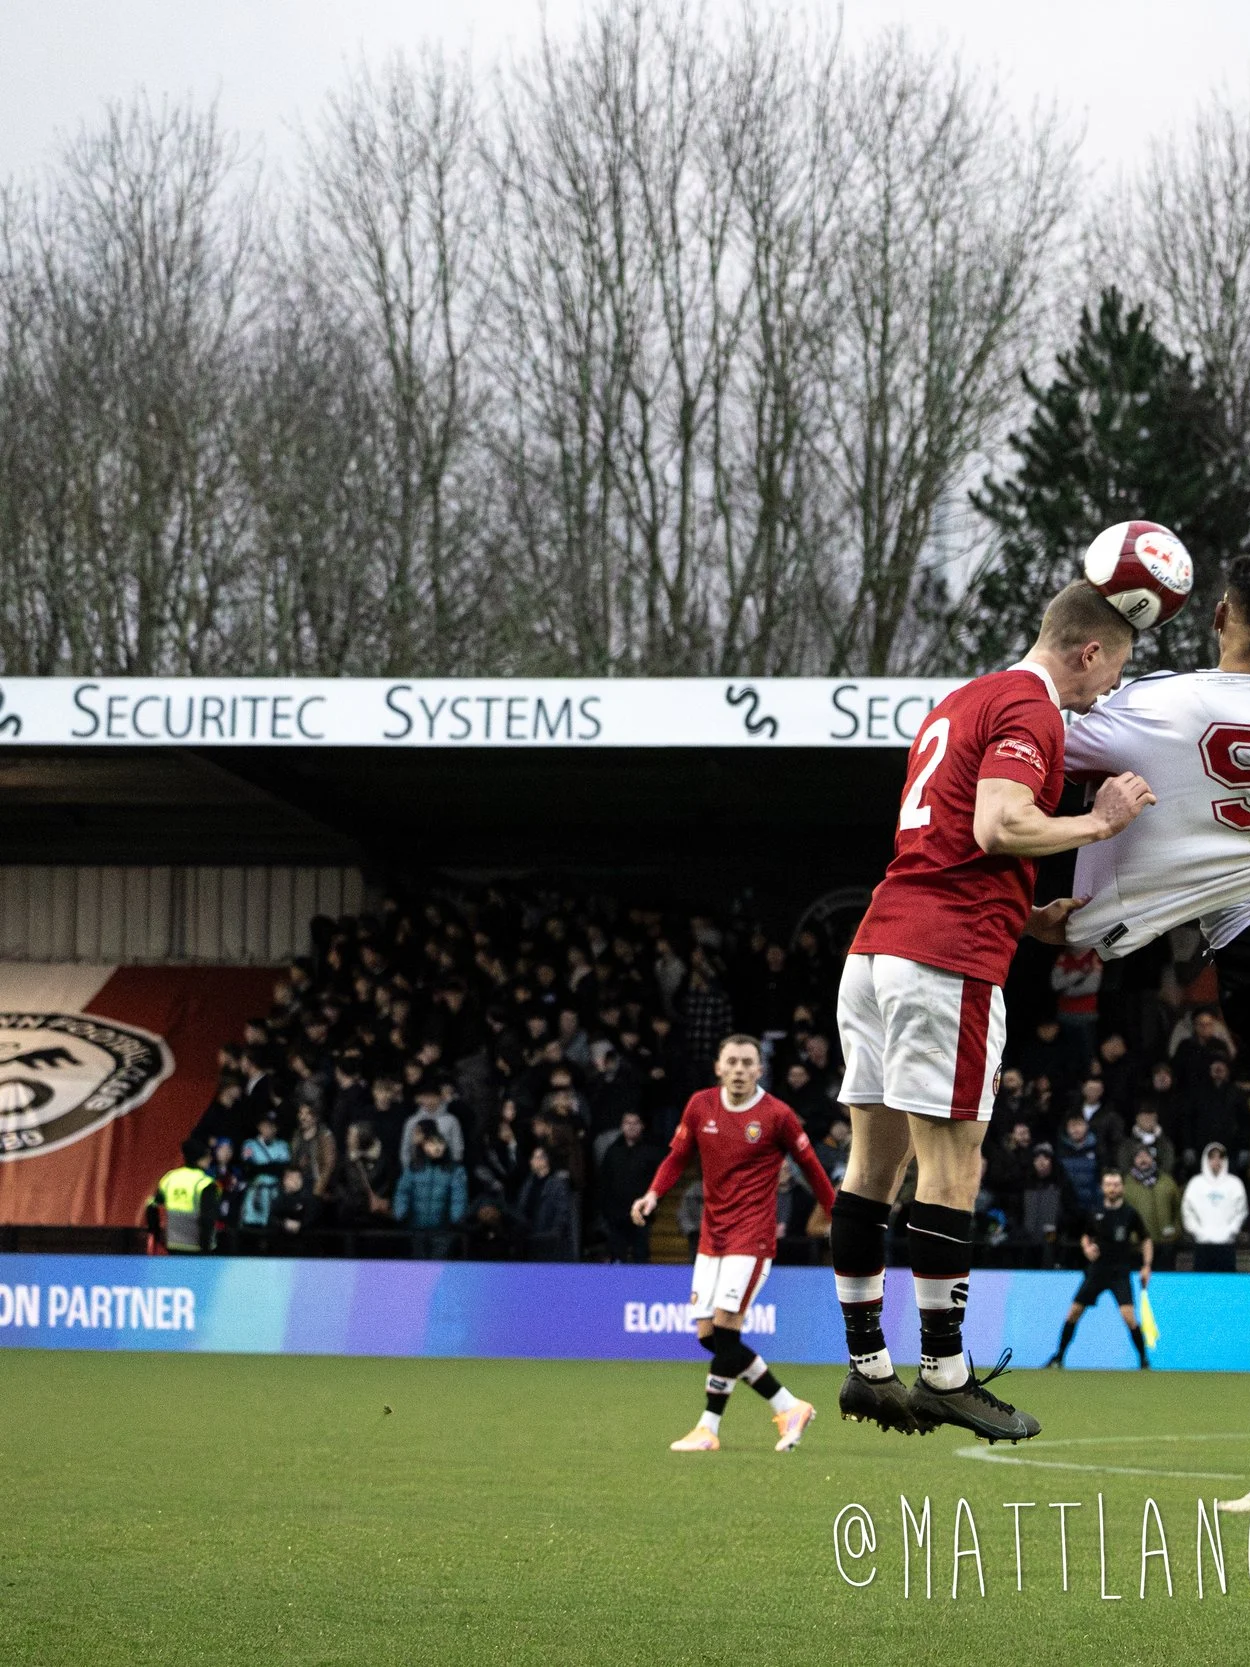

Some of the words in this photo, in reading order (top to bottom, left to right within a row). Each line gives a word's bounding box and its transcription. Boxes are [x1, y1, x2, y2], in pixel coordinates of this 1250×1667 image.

[70, 684, 326, 740] SECURITEC
[383, 684, 603, 740] SYSTEMS
[830, 684, 935, 740] SEC
[900, 717, 950, 831] 2
[48, 1285, 196, 1330] PARTNER
